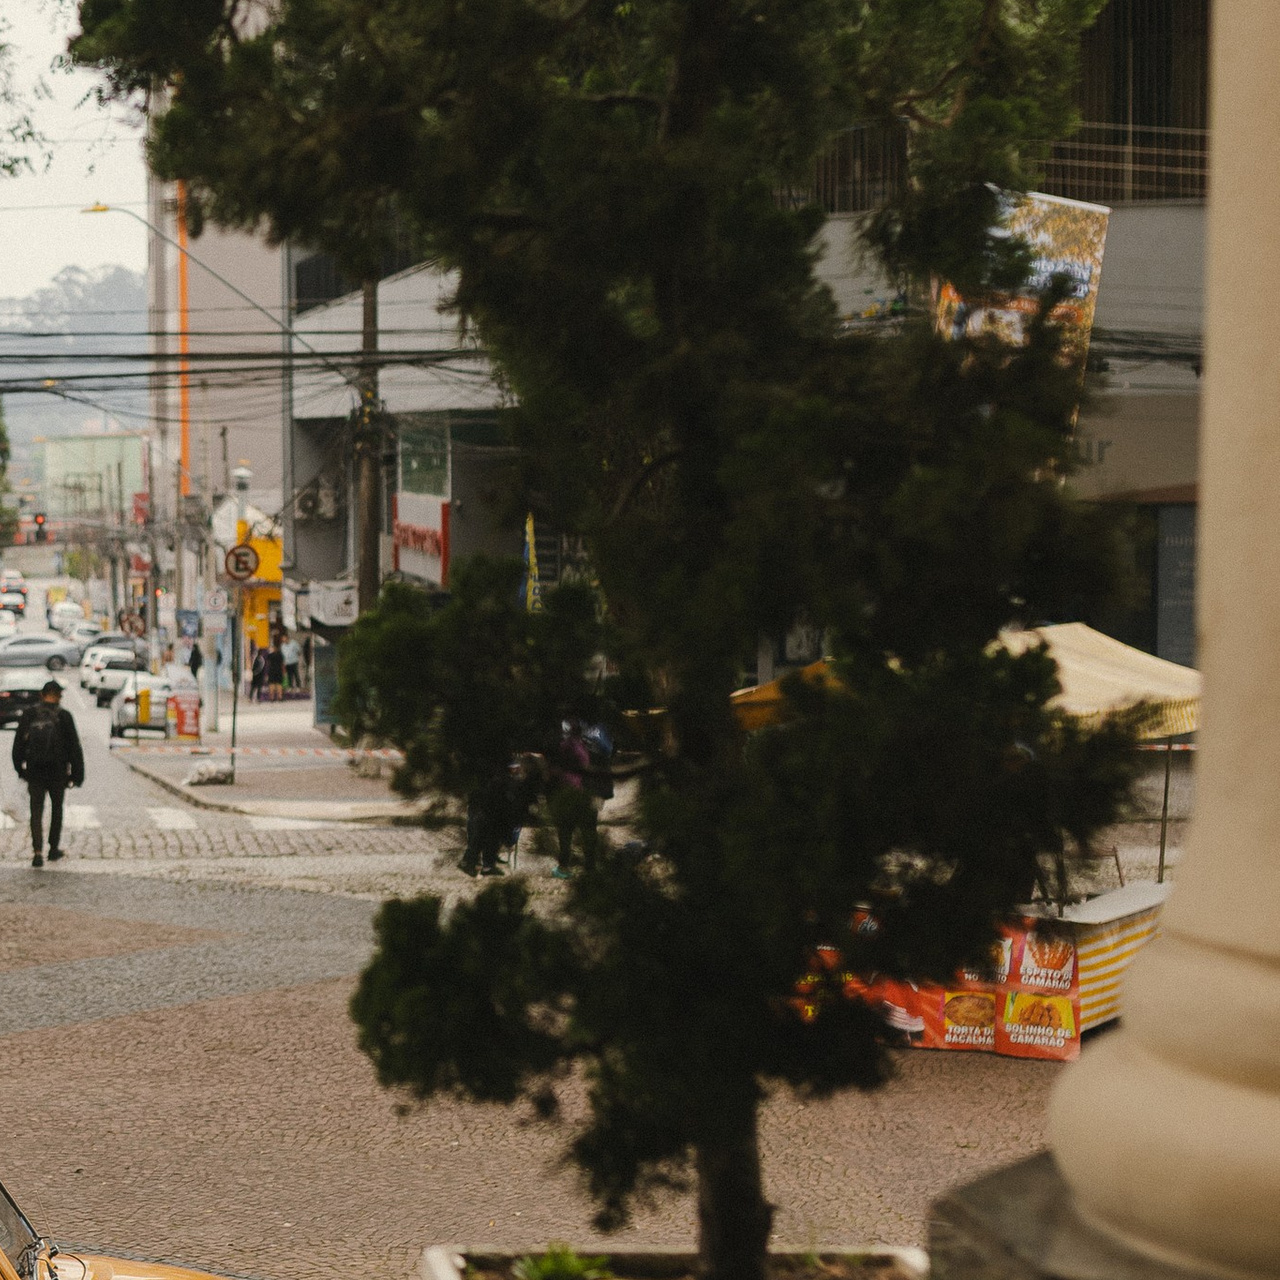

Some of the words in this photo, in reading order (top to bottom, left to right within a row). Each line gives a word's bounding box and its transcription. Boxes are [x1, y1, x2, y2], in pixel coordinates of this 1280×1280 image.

[948, 1025, 980, 1035] TORTA
[1004, 1023, 1054, 1037] BOLINHO
[1056, 1028, 1073, 1039] DE
[944, 1033, 995, 1045] BACALHA
